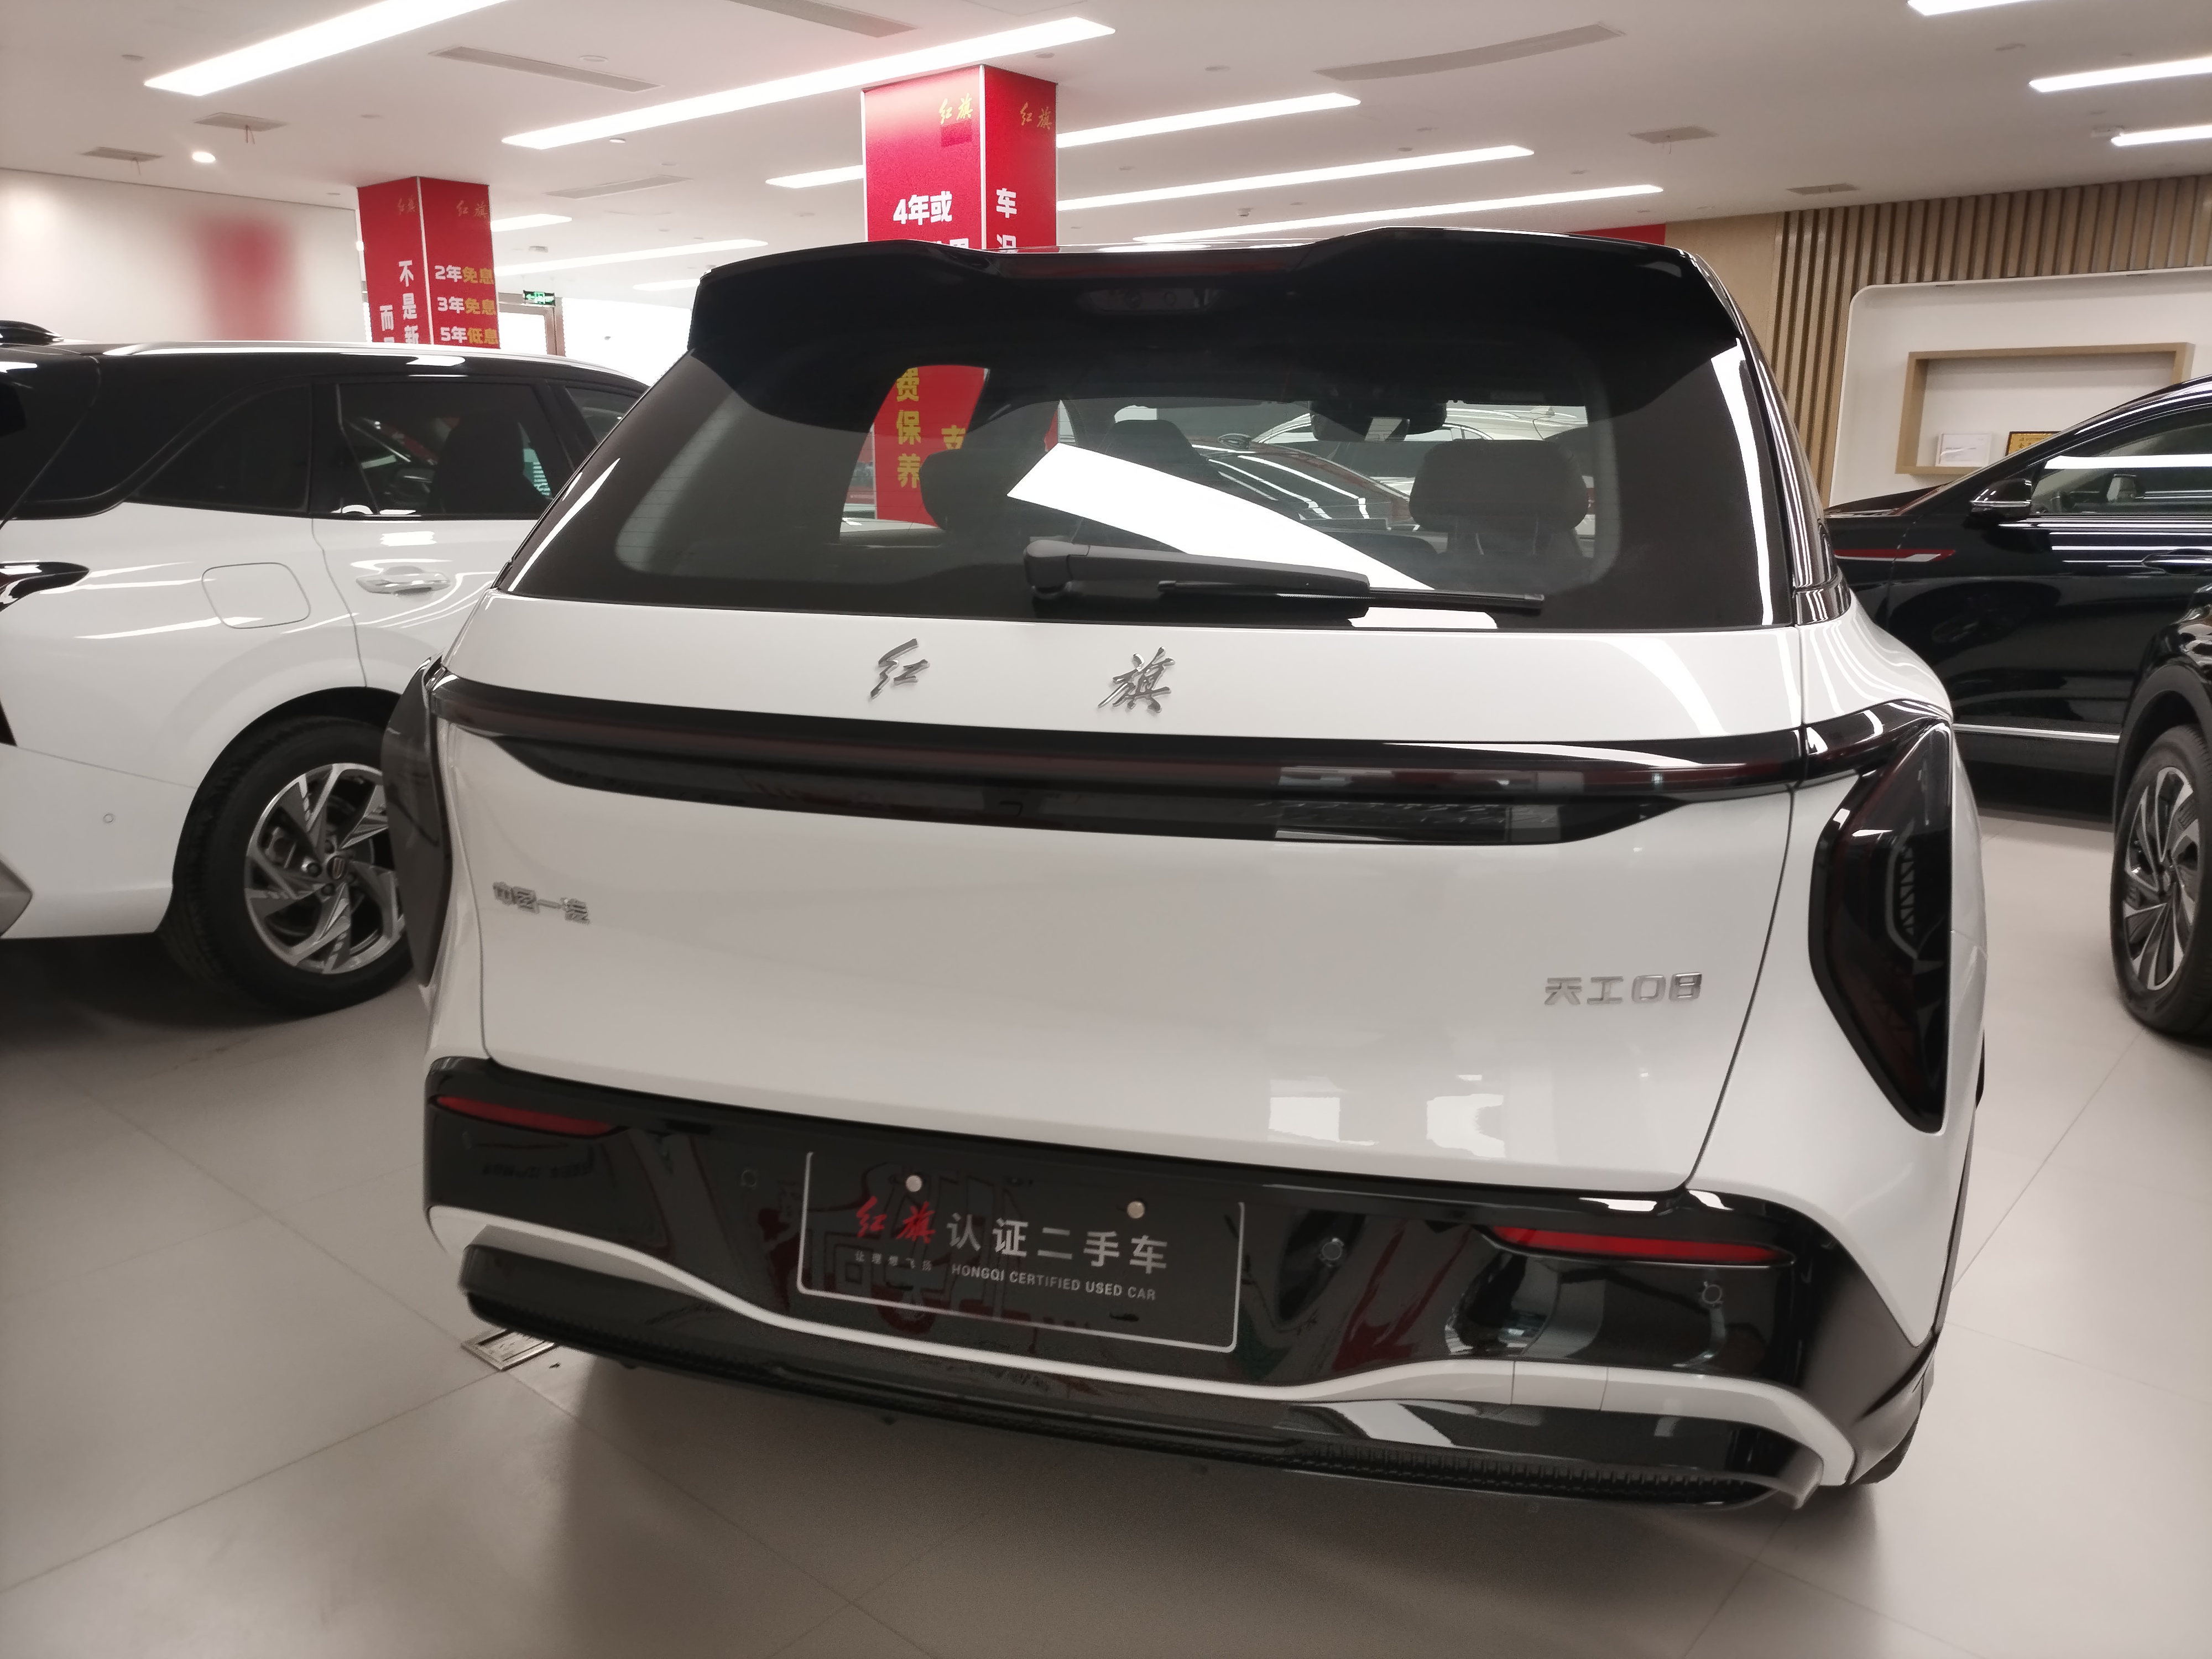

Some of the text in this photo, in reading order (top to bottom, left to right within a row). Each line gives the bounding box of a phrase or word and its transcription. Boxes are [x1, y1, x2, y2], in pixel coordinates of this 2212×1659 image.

[938, 93, 973, 124] 红旗
[1020, 102, 1053, 129] 红旗
[456, 200, 488, 220] 红旗
[893, 191, 952, 225] 4年或
[434, 265, 494, 285] 2年免息
[437, 296, 496, 316] 3年免息
[379, 305, 395, 343] 而
[440, 326, 498, 344] 5年低息
[1544, 972, 1703, 1005] 天工08
[855, 1196, 1168, 1275] 红旗 认证二手车
[951, 1263, 1157, 1301] HONGQI CERTIFIED USED CAR
